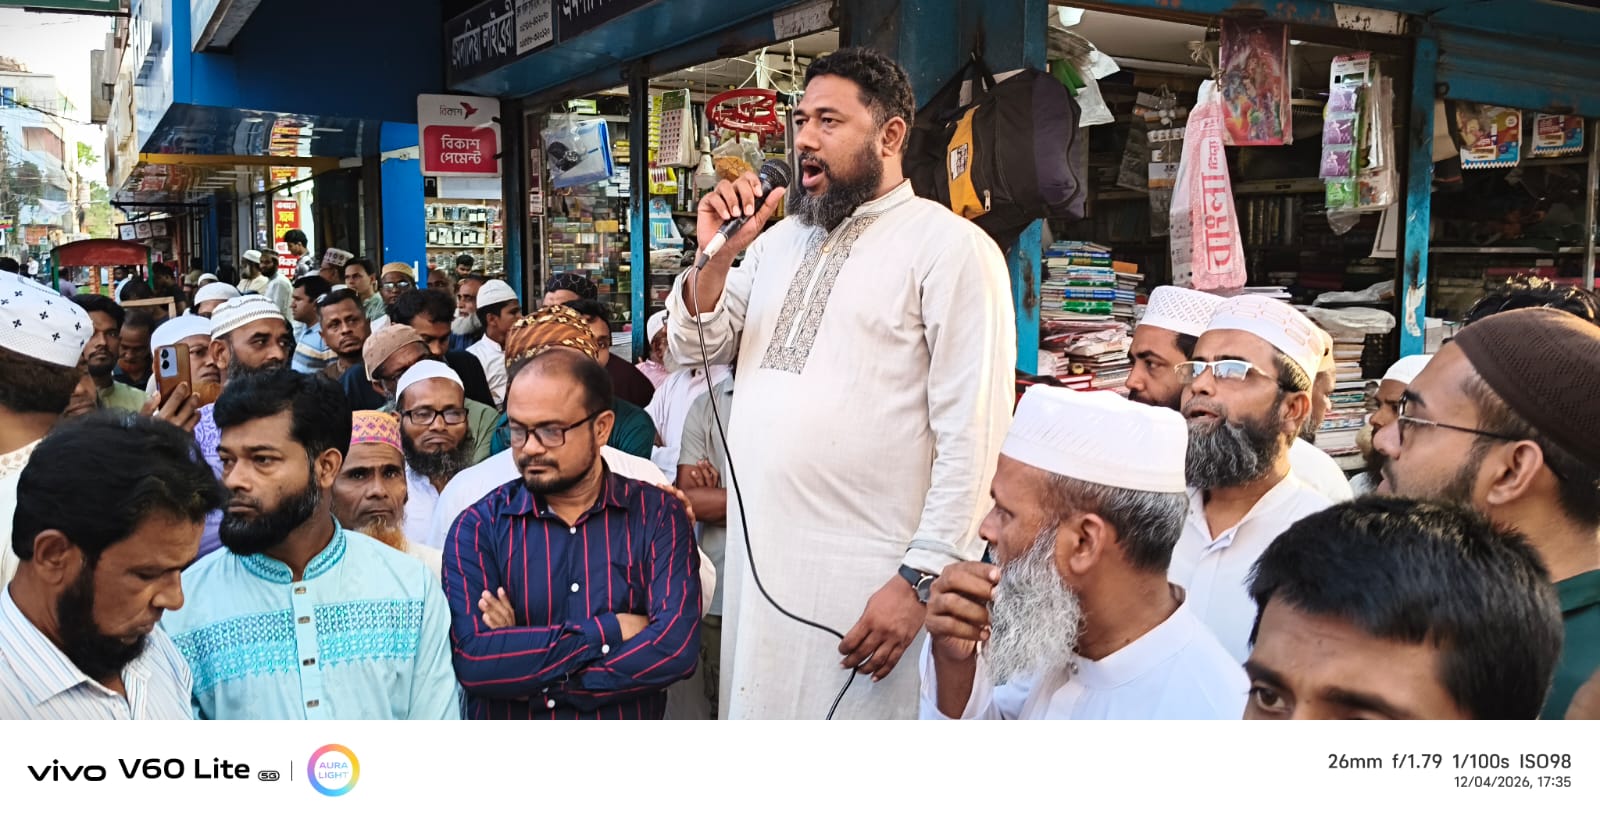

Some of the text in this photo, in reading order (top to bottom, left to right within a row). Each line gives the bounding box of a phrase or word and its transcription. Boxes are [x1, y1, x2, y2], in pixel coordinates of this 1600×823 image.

[440, 104, 462, 116] বিকাশ
[440, 134, 480, 149] বিকাশ
[440, 151, 482, 164] পেমেন্ট
[1201, 172, 1231, 270] বাংলা
